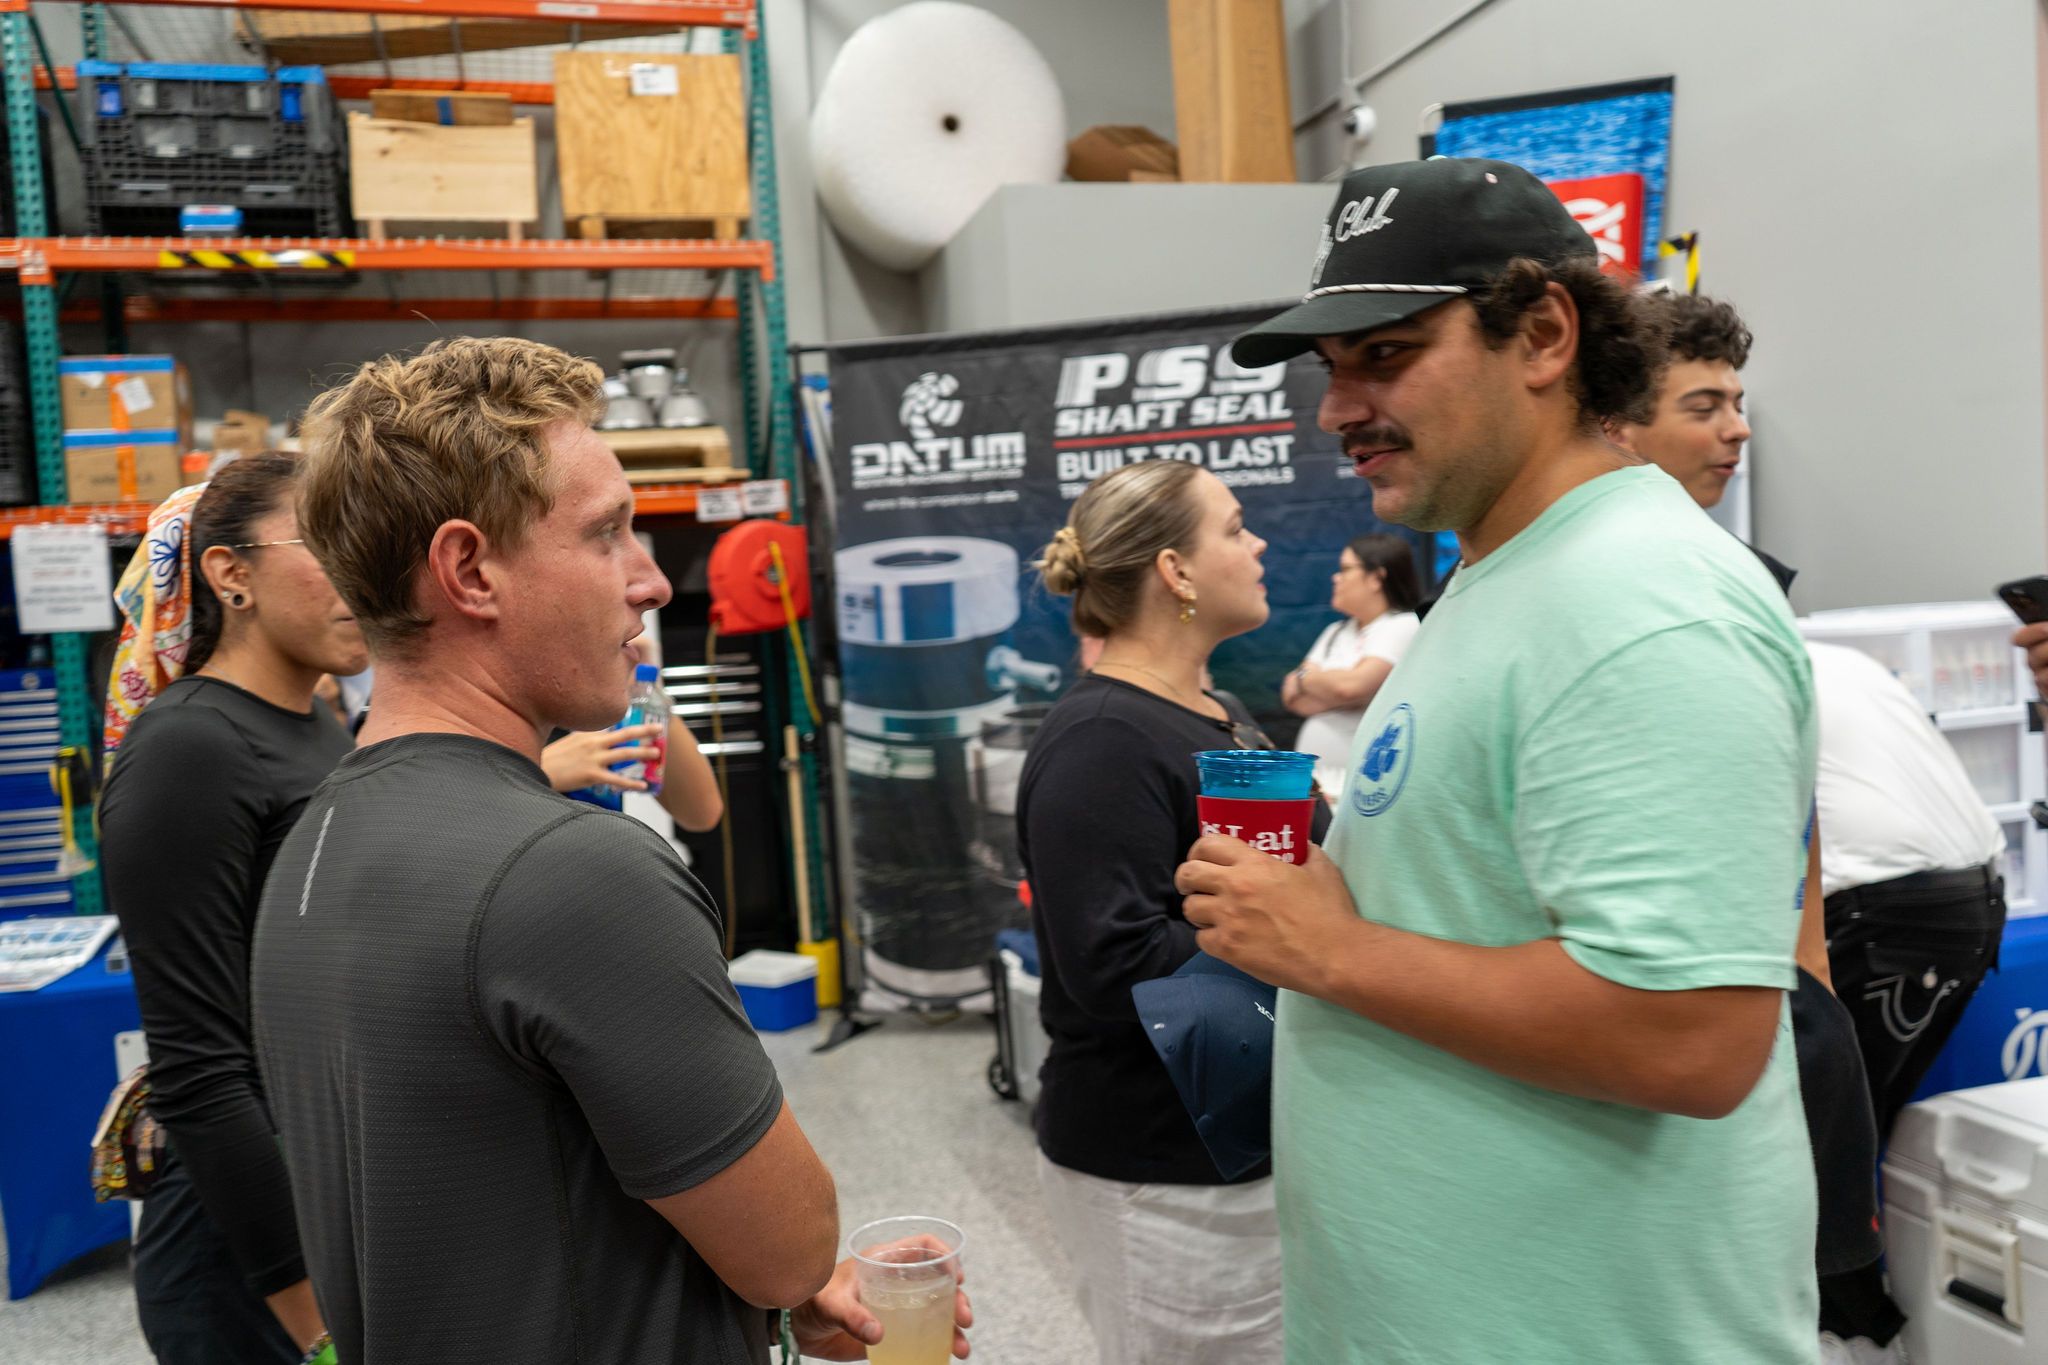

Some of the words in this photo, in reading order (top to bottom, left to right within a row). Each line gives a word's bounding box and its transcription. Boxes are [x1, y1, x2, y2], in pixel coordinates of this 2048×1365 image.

[1335, 187, 1400, 242] Club
[1054, 344, 1287, 409] PSS
[1054, 400, 1185, 437] SHAFT
[1189, 390, 1293, 426] SEAL
[851, 431, 1027, 478] DATUM
[1208, 434, 1296, 470] LAST
